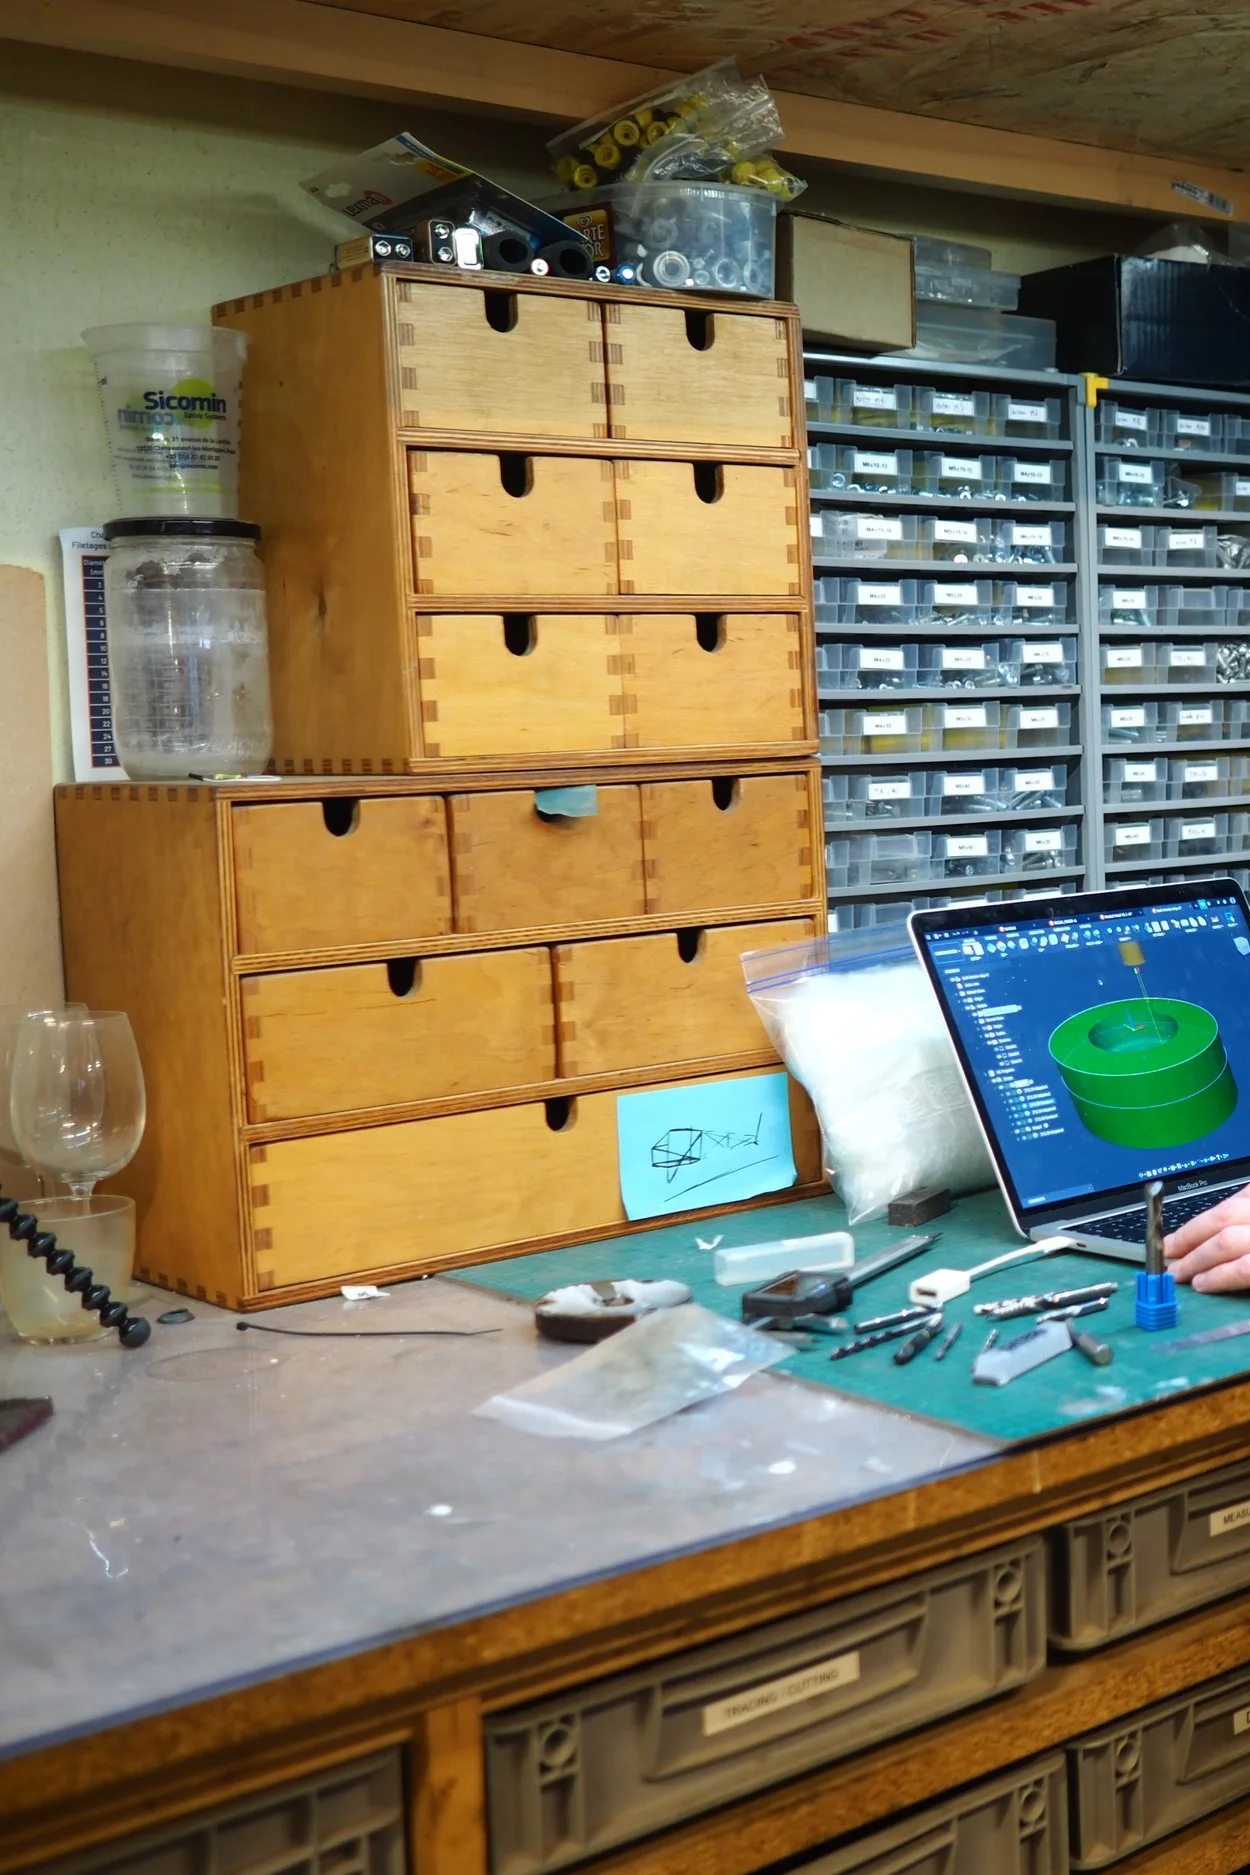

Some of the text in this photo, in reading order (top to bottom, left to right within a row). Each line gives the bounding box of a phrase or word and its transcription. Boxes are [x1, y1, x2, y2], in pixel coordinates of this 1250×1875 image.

[143, 391, 227, 414] Sicomin
[104, 745, 112, 753] 27
[1177, 1181, 1199, 1192] MacBook
[787, 1668, 840, 1697] CUTTING
